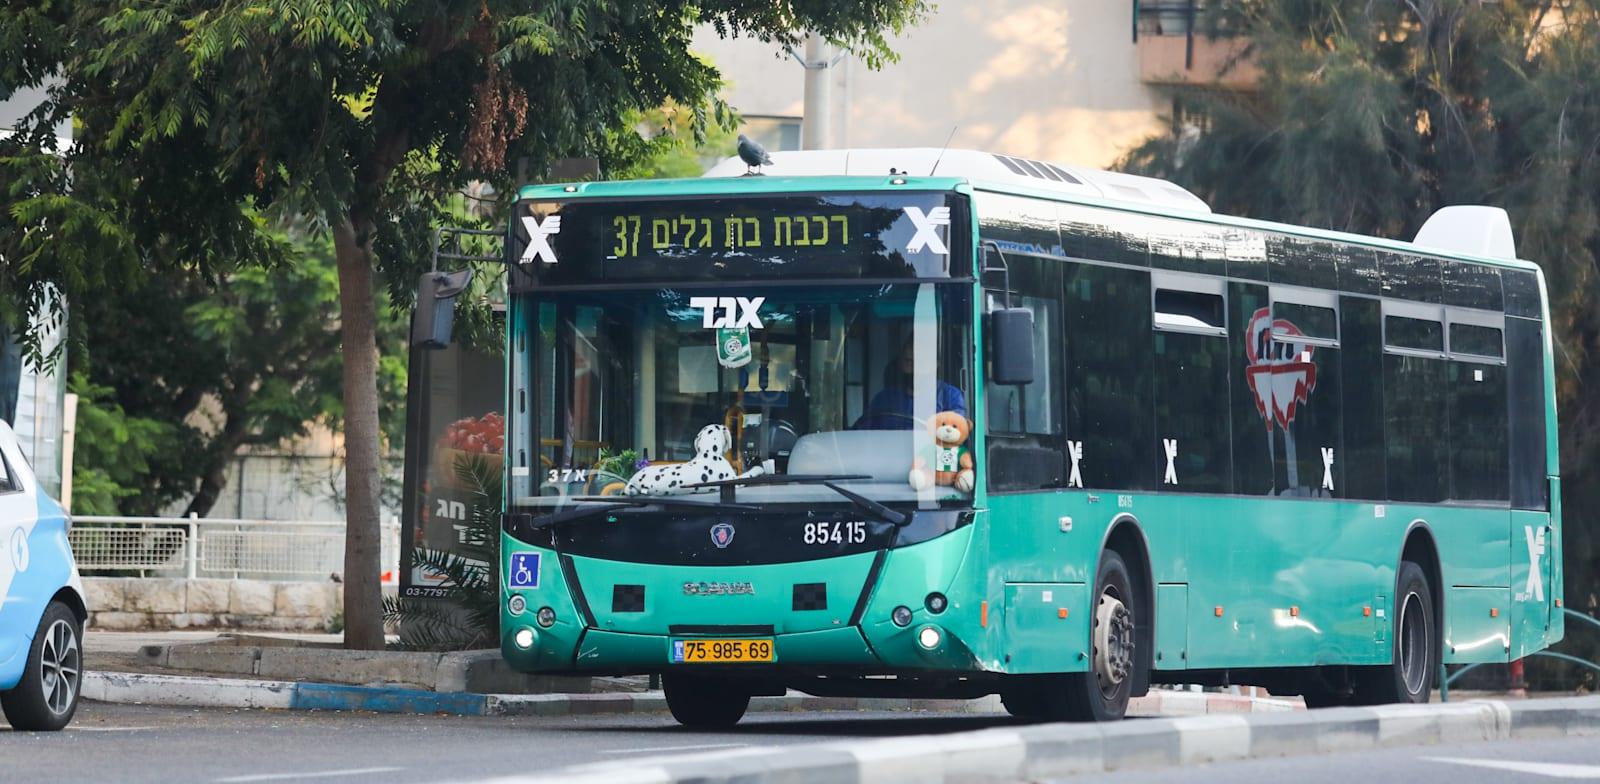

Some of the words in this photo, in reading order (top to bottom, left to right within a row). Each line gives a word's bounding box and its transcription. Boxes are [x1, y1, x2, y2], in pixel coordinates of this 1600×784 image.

[613, 215, 641, 257] 37
[652, 214, 712, 249] גלים
[724, 217, 761, 248] בת
[774, 215, 849, 246] רכבת
[690, 296, 766, 329] אגד
[436, 499, 466, 521] חג
[803, 521, 866, 545] 85415
